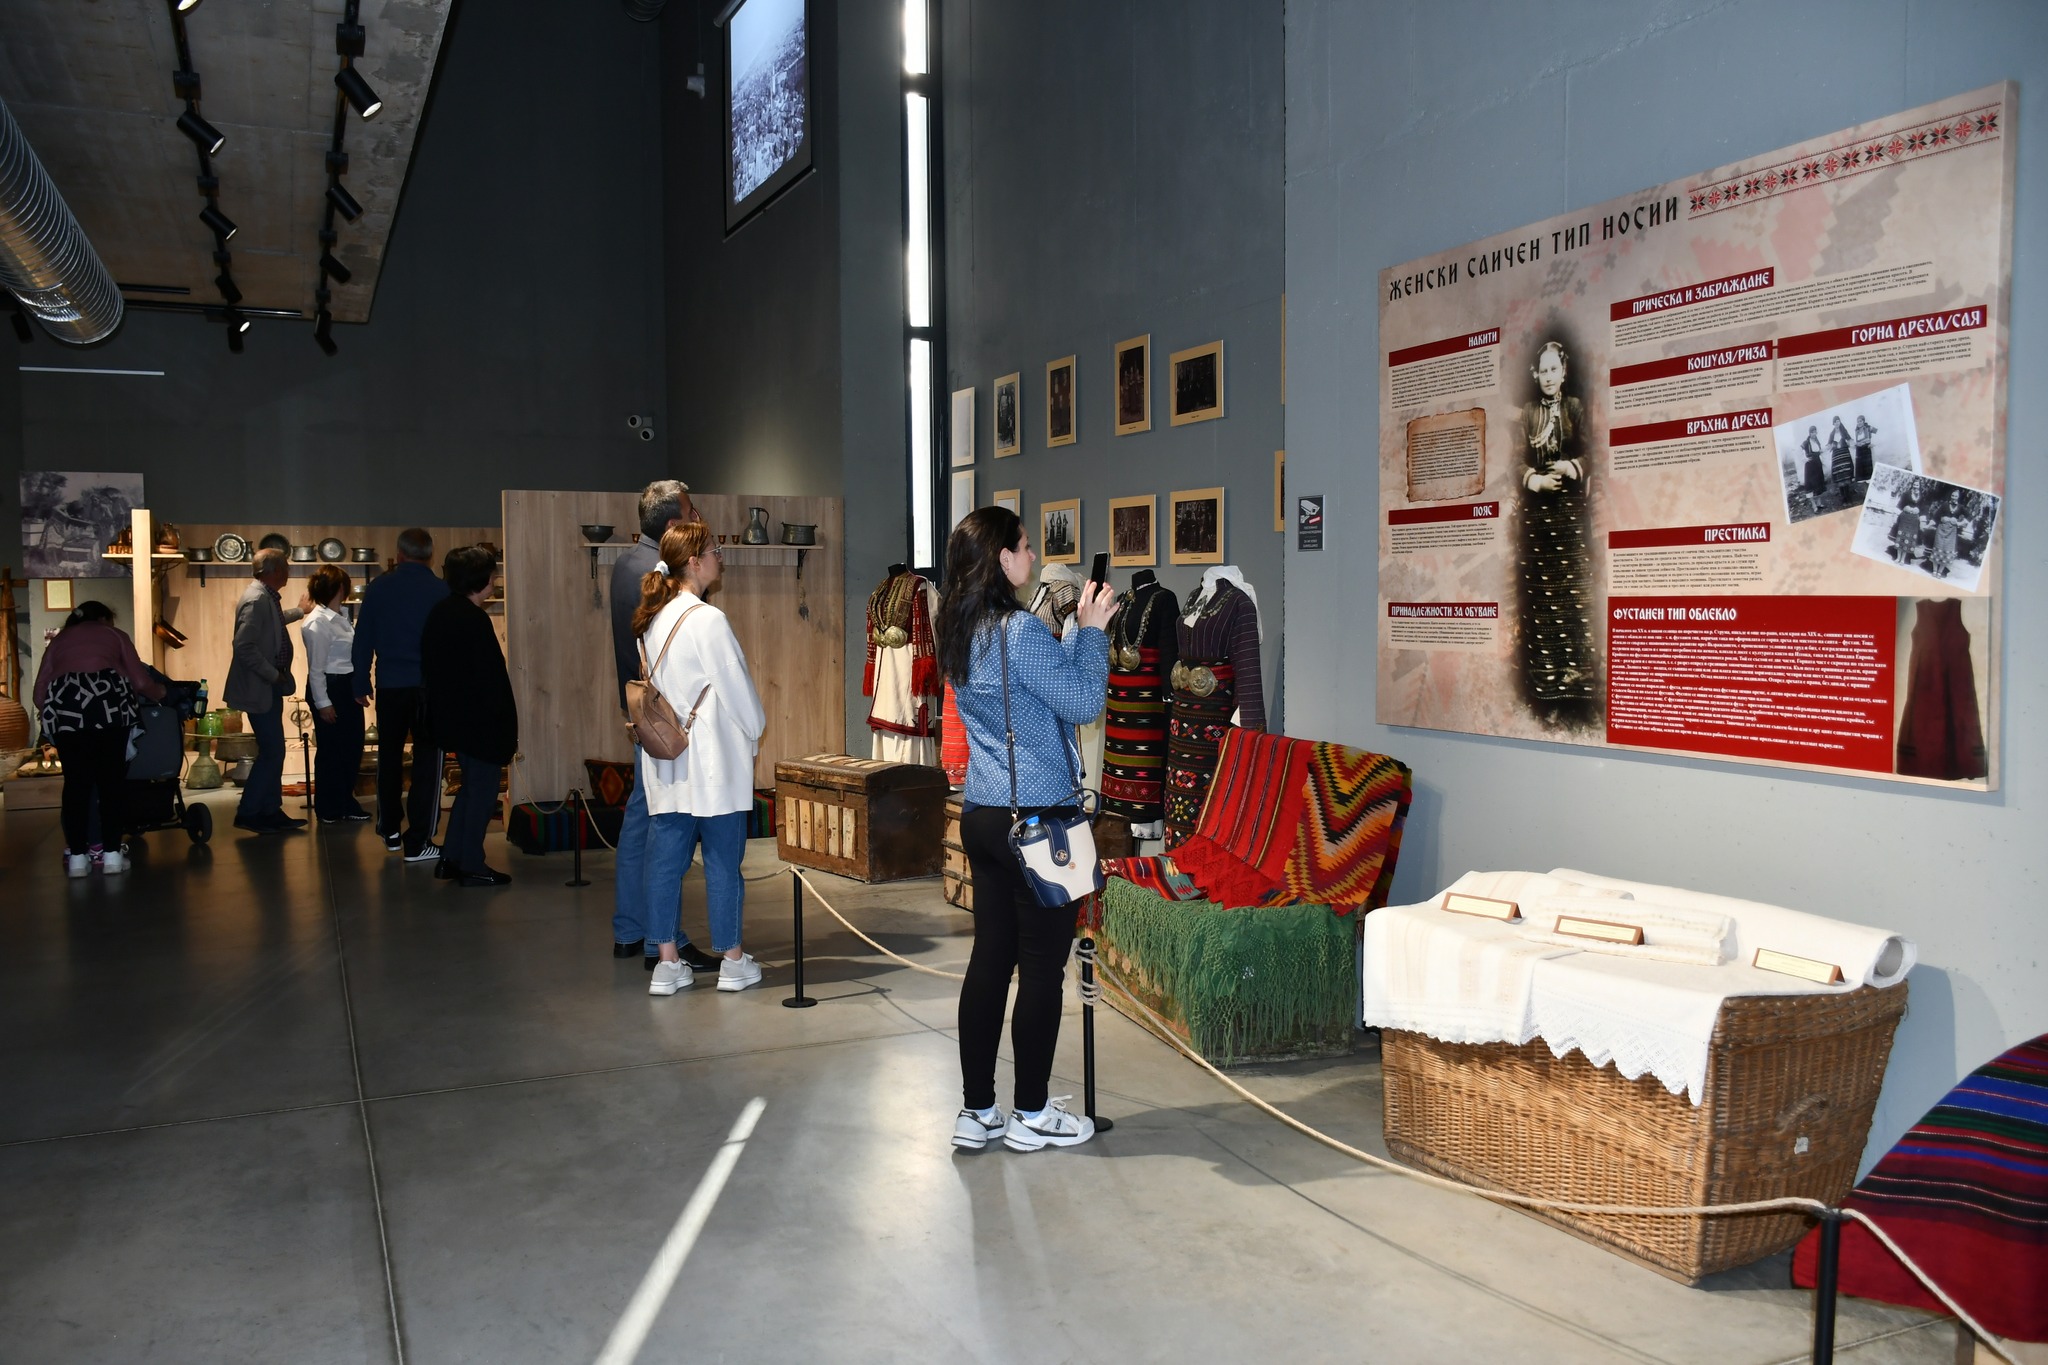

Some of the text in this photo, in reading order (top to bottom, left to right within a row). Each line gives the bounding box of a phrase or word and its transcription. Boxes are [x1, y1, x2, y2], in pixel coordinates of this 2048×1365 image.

[1390, 197, 1677, 301] ЖЕНСКИ САИЧЕН ТИП НОСИИ
[1633, 272, 1769, 314] ПРИЧЕСКА И ЗАБРАЖДАНЕ
[1851, 311, 1980, 344] ГОРНА ДРЕХА/САЯ
[1469, 331, 1497, 347] НАКИТИ
[1688, 345, 1767, 371] КОШУЛЯ/РИЗА
[1687, 412, 1769, 434] ВРЪХНА ДРЕХА
[1473, 505, 1492, 517] ПОЯС
[1704, 527, 1767, 542] ПРЕСТИЛКА
[1391, 606, 1497, 617] ПРИНАДЛЕЖНОСТИ ЗА ОБУВАНЕ
[1613, 608, 1737, 621] ФУСТАНЕН ТИП ОБЛЕКЛО
